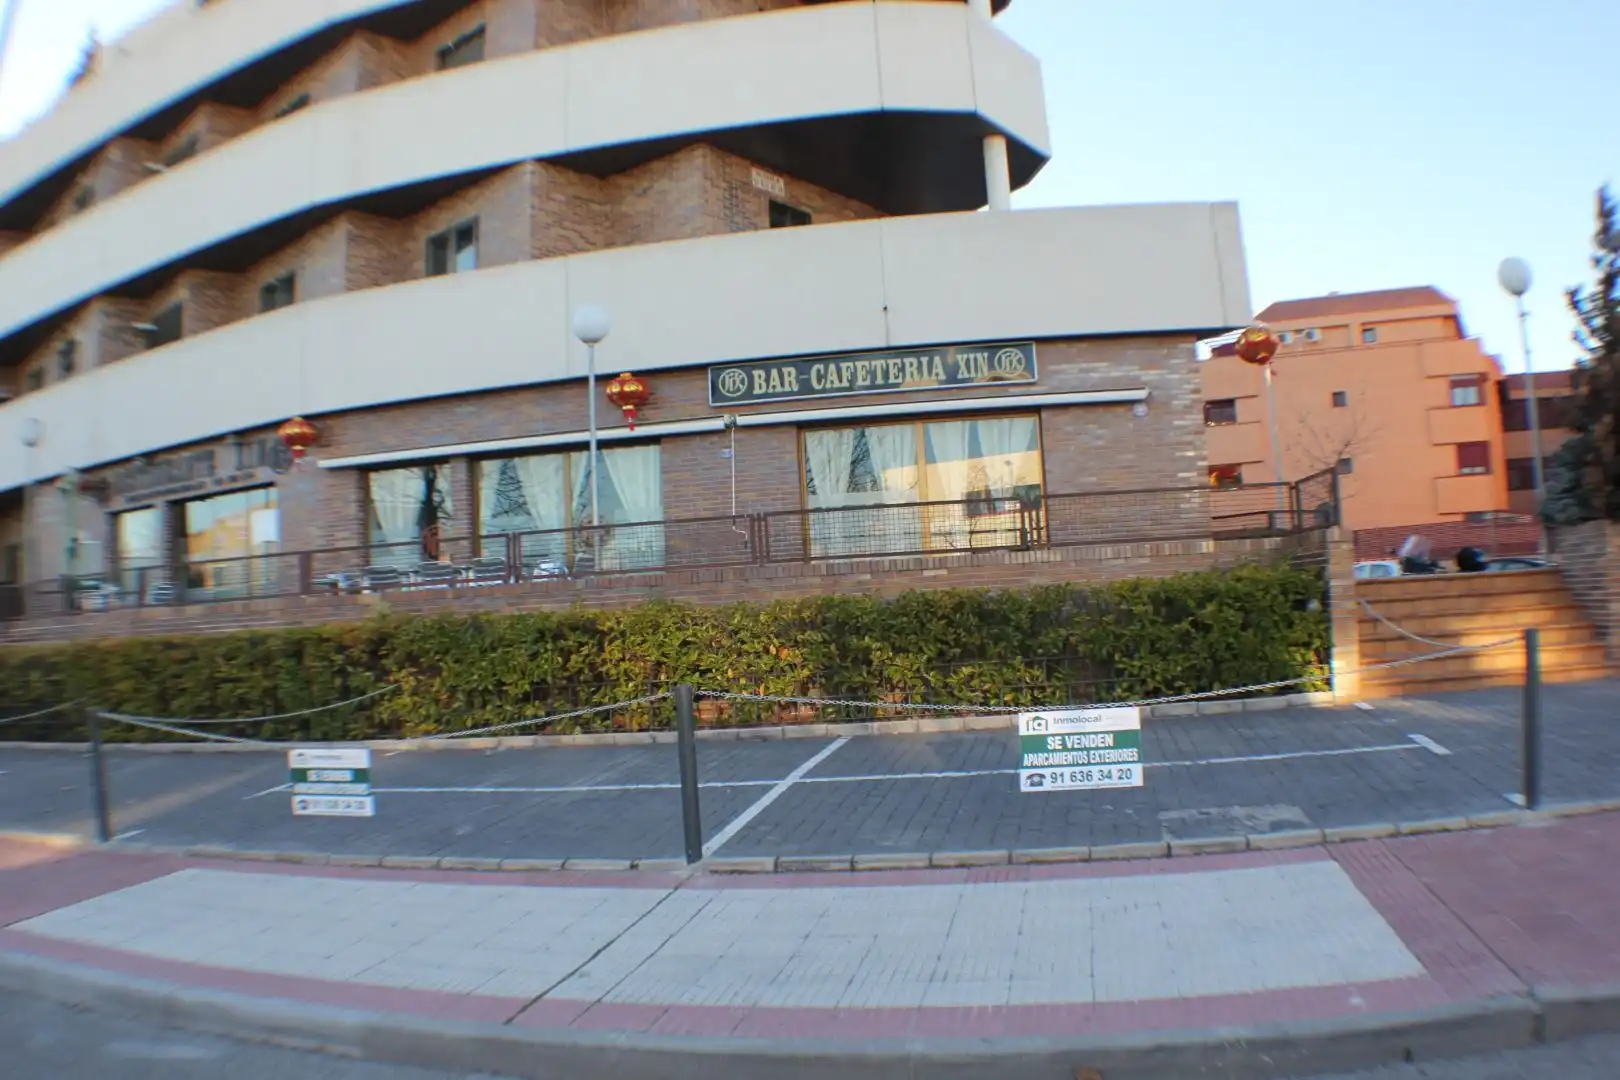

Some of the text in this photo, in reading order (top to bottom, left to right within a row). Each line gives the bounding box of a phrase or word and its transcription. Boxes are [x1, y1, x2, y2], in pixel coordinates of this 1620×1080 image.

[956, 352, 988, 379] XIN
[1047, 733, 1114, 750] SE VENDEN
[1023, 748, 1139, 767] APARCAMIENTOS EXTERIORES
[1050, 768, 1133, 784] 91 636 34 20
